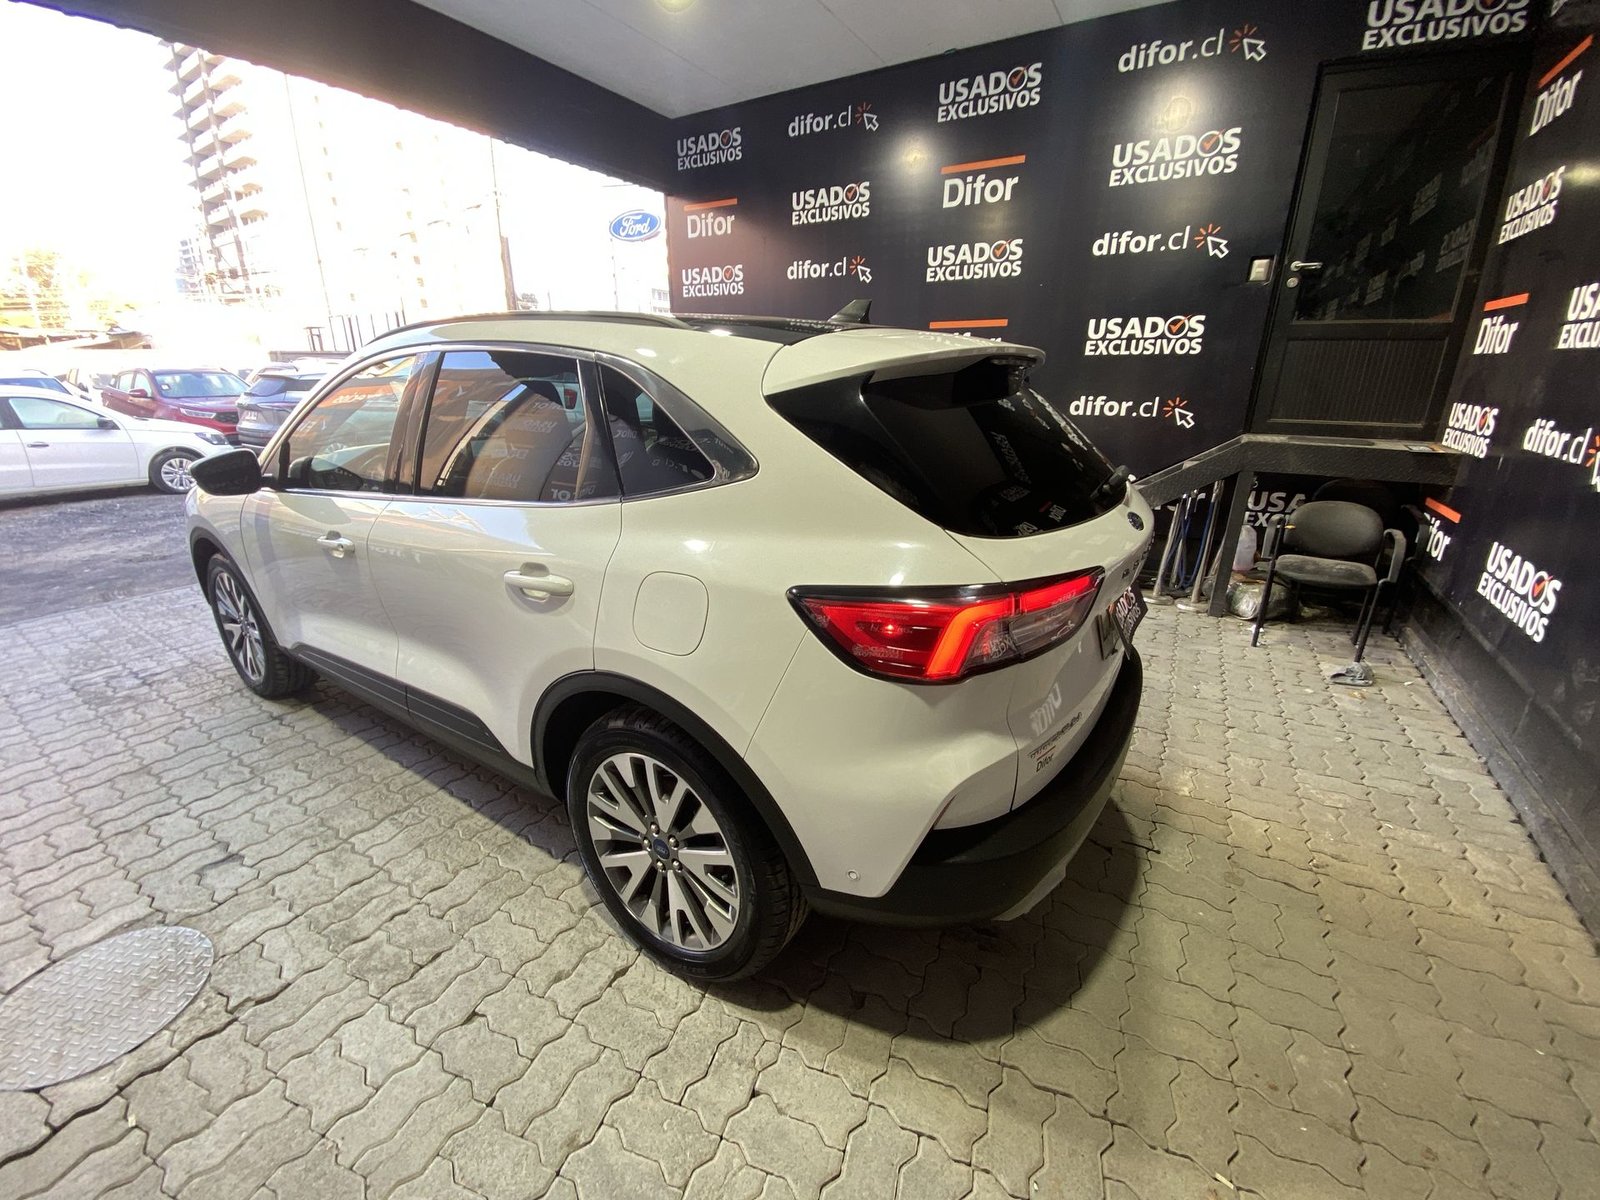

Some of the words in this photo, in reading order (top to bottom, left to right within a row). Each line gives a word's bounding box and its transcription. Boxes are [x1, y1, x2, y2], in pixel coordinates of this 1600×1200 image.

[1362, 10, 1527, 50] EXCLUSIVOS
[1118, 28, 1224, 73] difor.cl
[939, 62, 1043, 105] USADOS
[937, 87, 1041, 122] EXCLUSIVOS
[1529, 70, 1583, 137] Difor
[788, 105, 852, 138] difor.cl
[676, 127, 742, 157] USADOS
[677, 146, 743, 171] EXCLUSIVOS
[1113, 127, 1242, 168] USADOS
[1109, 153, 1239, 187] EXCLUSIVOS
[791, 182, 871, 211] USADOS
[942, 173, 1020, 209] Difor
[1505, 165, 1566, 222] USADOS
[687, 212, 735, 240] Difor
[791, 202, 871, 226] EXCLUSIVOS
[1498, 200, 1558, 245] EXCLUSIVOS
[927, 239, 1024, 267] USADOS
[1092, 225, 1191, 257] difor.cl
[681, 264, 744, 285] USADOS
[787, 256, 847, 281] difor.cl
[926, 259, 1022, 283] EXCLUSIVOS
[682, 281, 744, 298] EXCLUSIVOS
[1087, 315, 1206, 340] USADOS
[1473, 315, 1519, 355] Difor
[1084, 338, 1203, 356] EXCLUSIVOS
[1069, 396, 1160, 417] difor.cl
[1448, 402, 1499, 437] USADOS
[1441, 428, 1490, 459] EXCLUSIVOS
[1523, 418, 1592, 465] difor.cl
[1415, 512, 1451, 561] ifor
[1486, 541, 1562, 615] USADOS
[1477, 571, 1549, 643] EXCLUSIVOS
